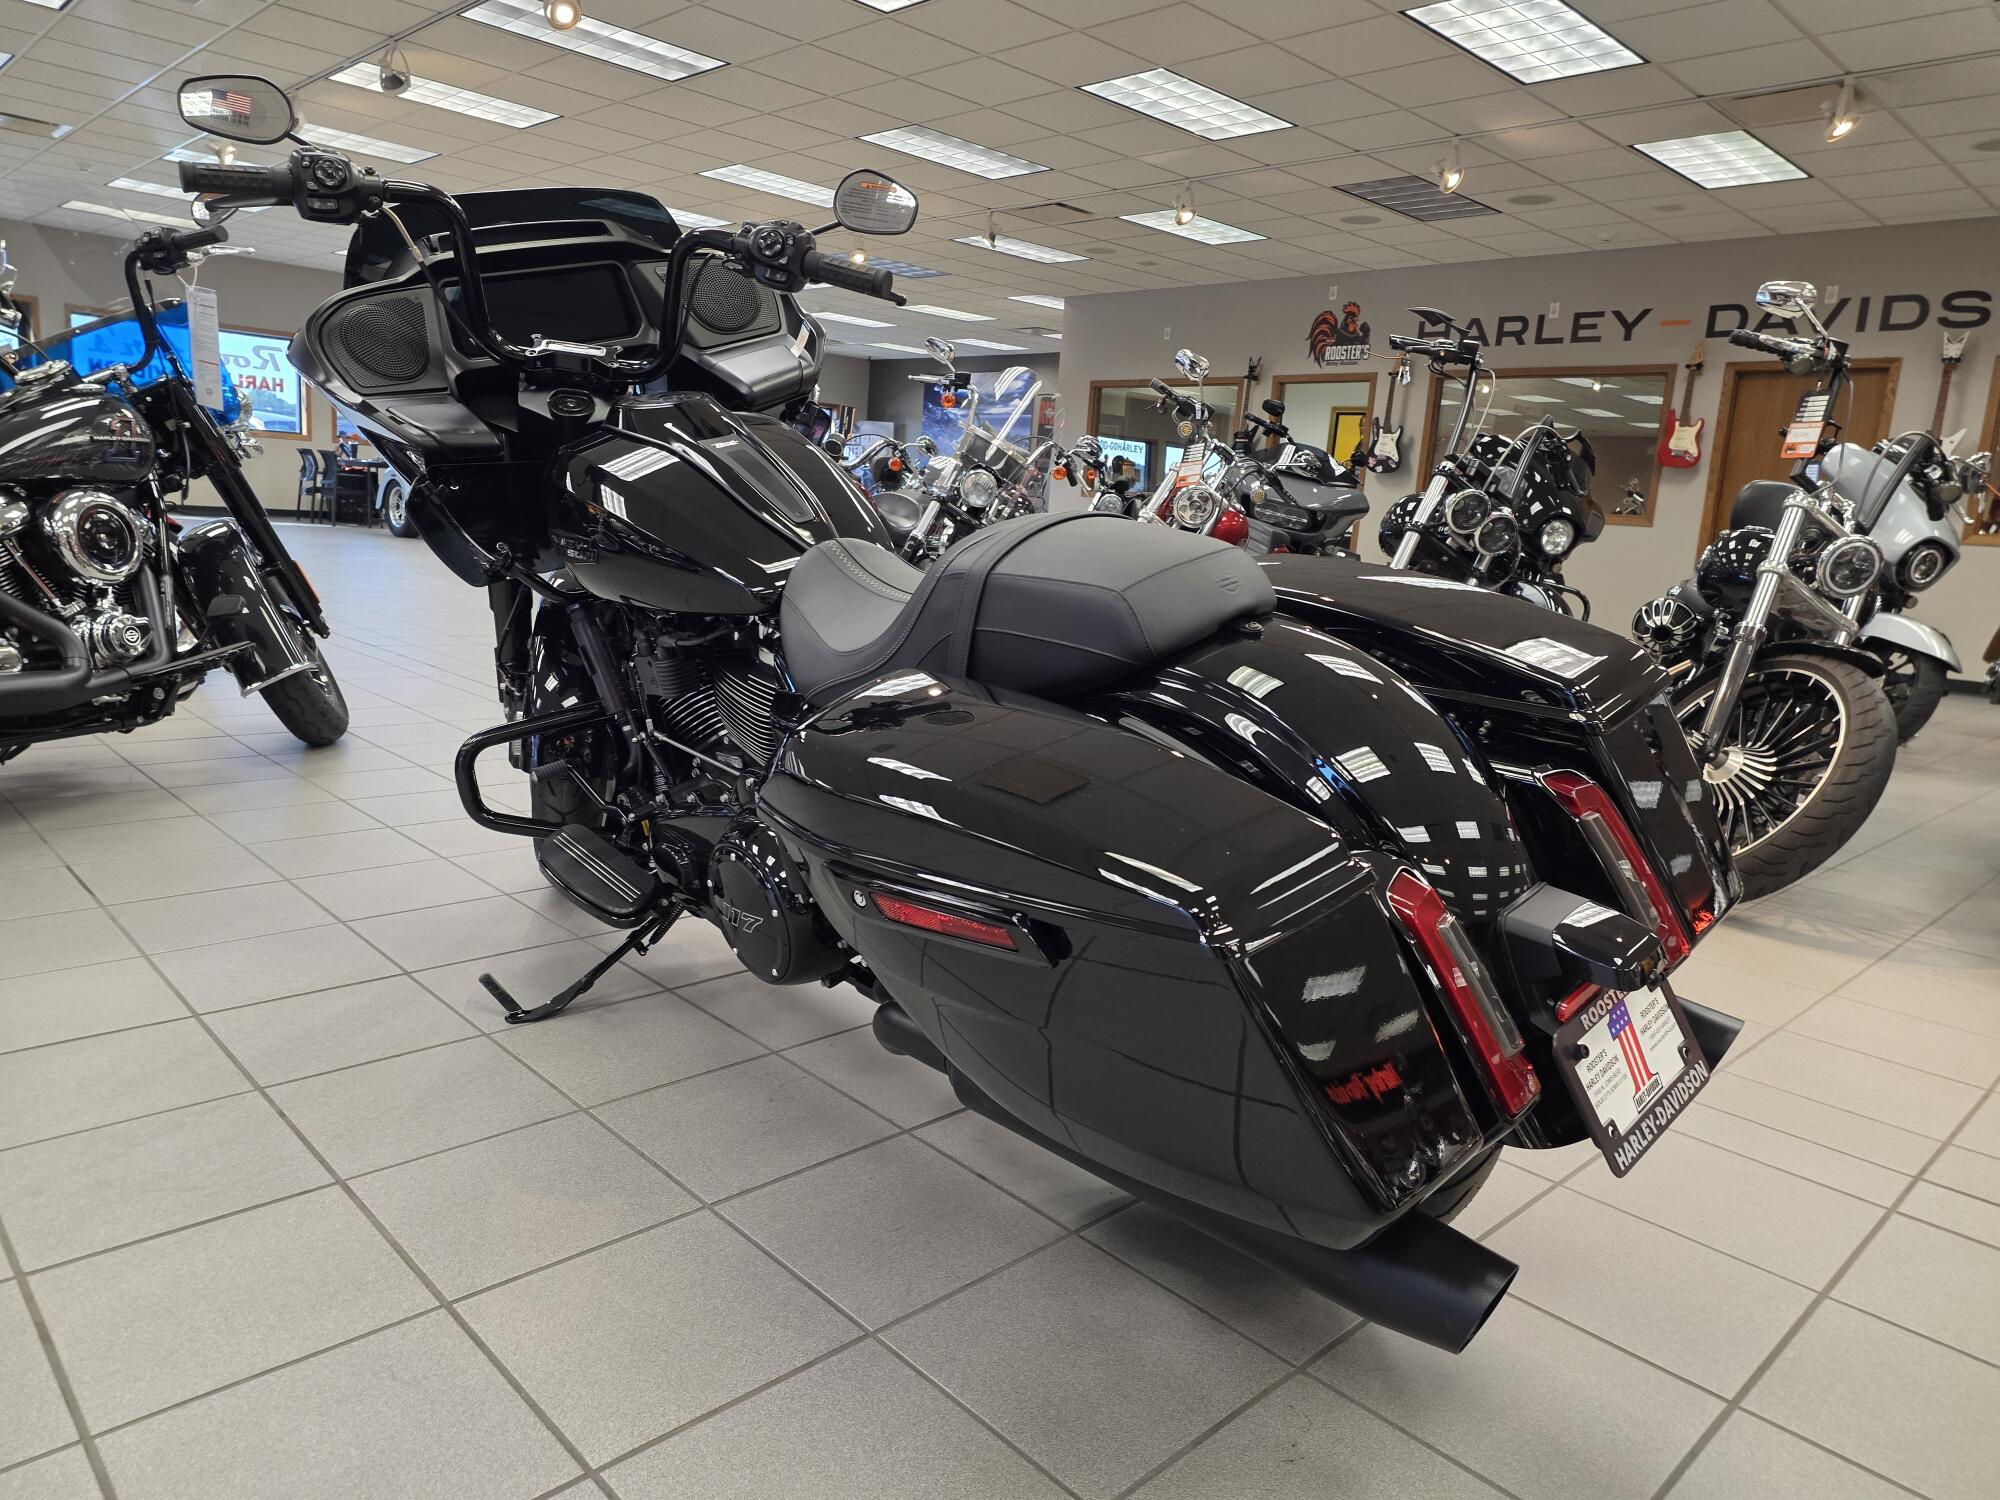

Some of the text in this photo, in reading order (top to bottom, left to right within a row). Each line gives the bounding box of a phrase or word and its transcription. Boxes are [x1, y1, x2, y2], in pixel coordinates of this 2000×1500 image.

[1324, 344, 1370, 361] ROOSTER'S
[722, 901, 764, 933] 117
[1581, 989, 1628, 1031] ROOSTE
[1586, 1048, 1607, 1073] ROOSTER'S
[1586, 1072, 1601, 1091] HARLEY
[1600, 1053, 1619, 1078] DAVIDSON
[1614, 1060, 1709, 1171] HARLEY-DAVIDSON
